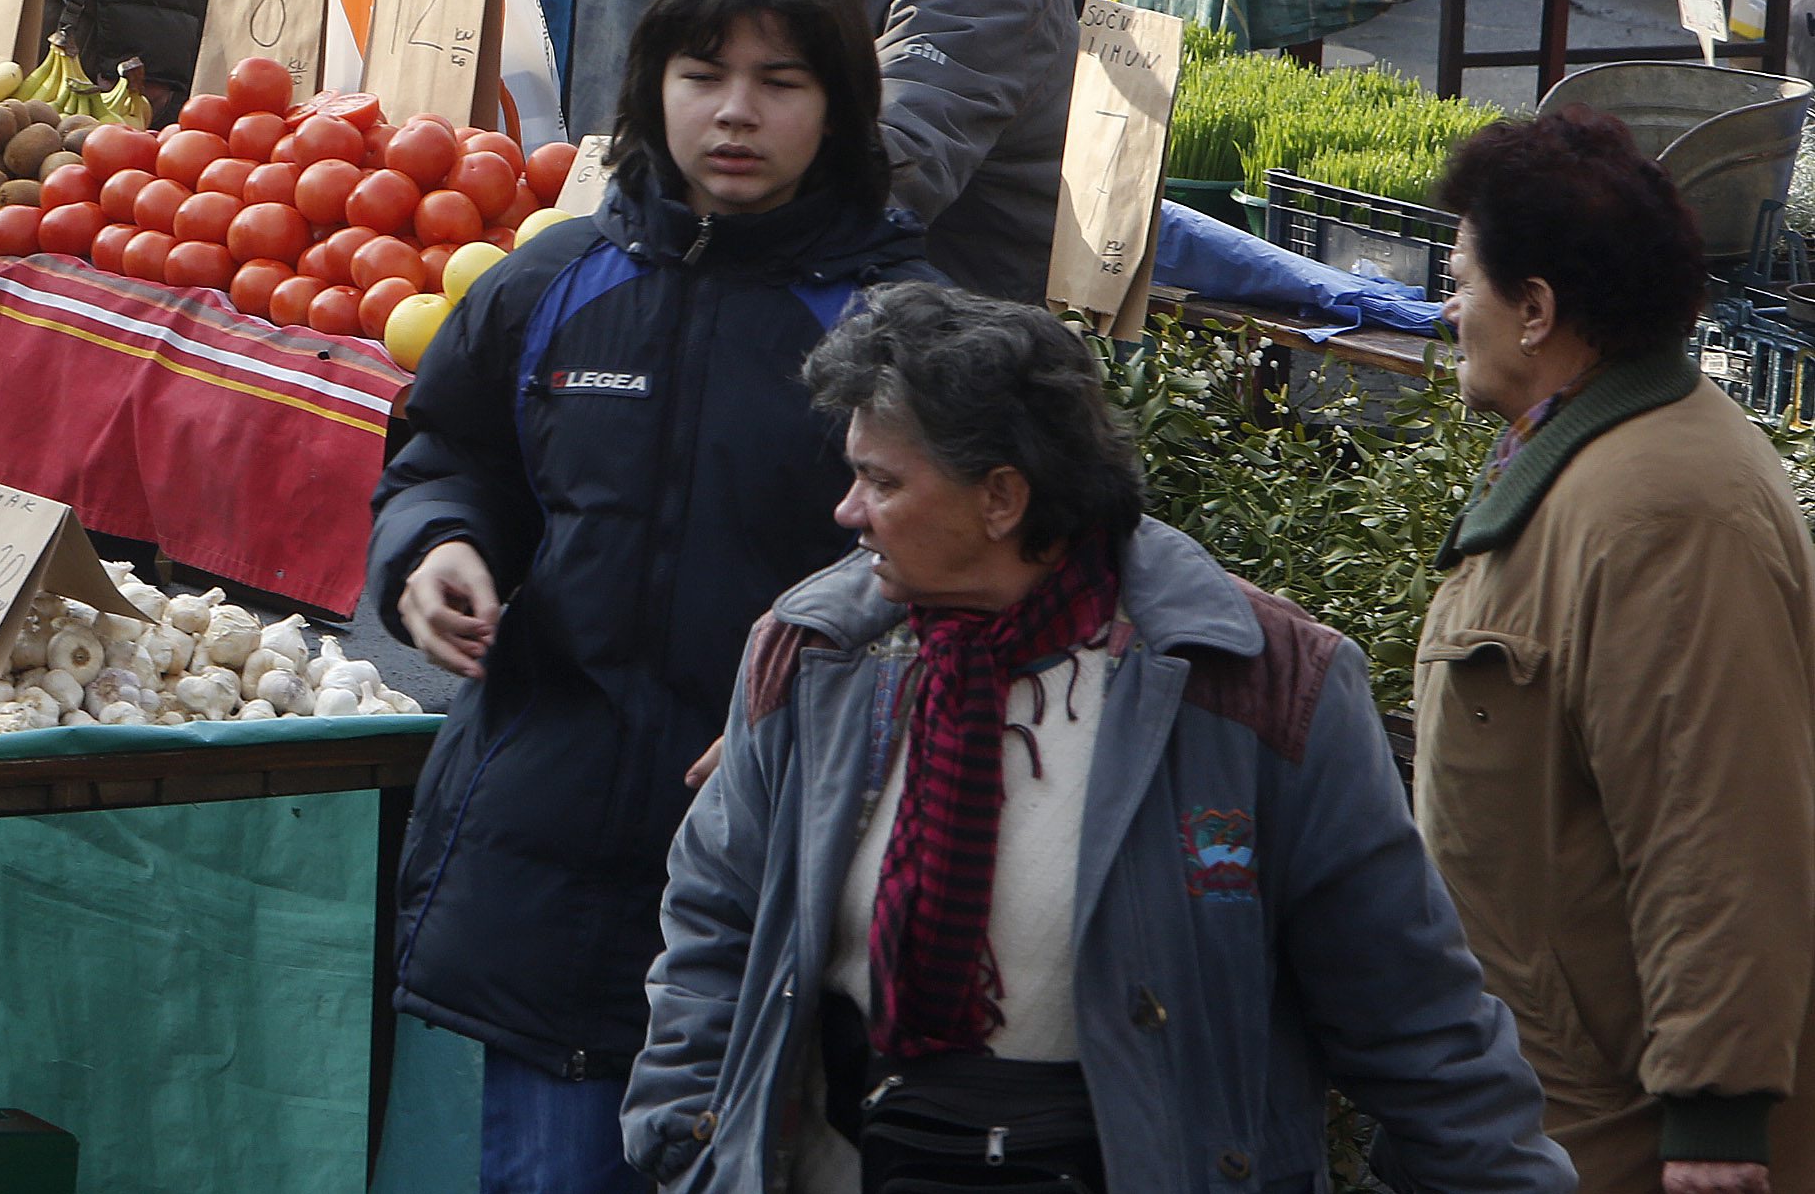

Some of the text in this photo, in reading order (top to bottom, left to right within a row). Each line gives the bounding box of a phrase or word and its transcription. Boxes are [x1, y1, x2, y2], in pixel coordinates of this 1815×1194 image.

[904, 43, 947, 65] Gill
[1086, 35, 1161, 70] LIMUN
[1088, 110, 1128, 230] 7
[564, 371, 647, 392] LEGEA
